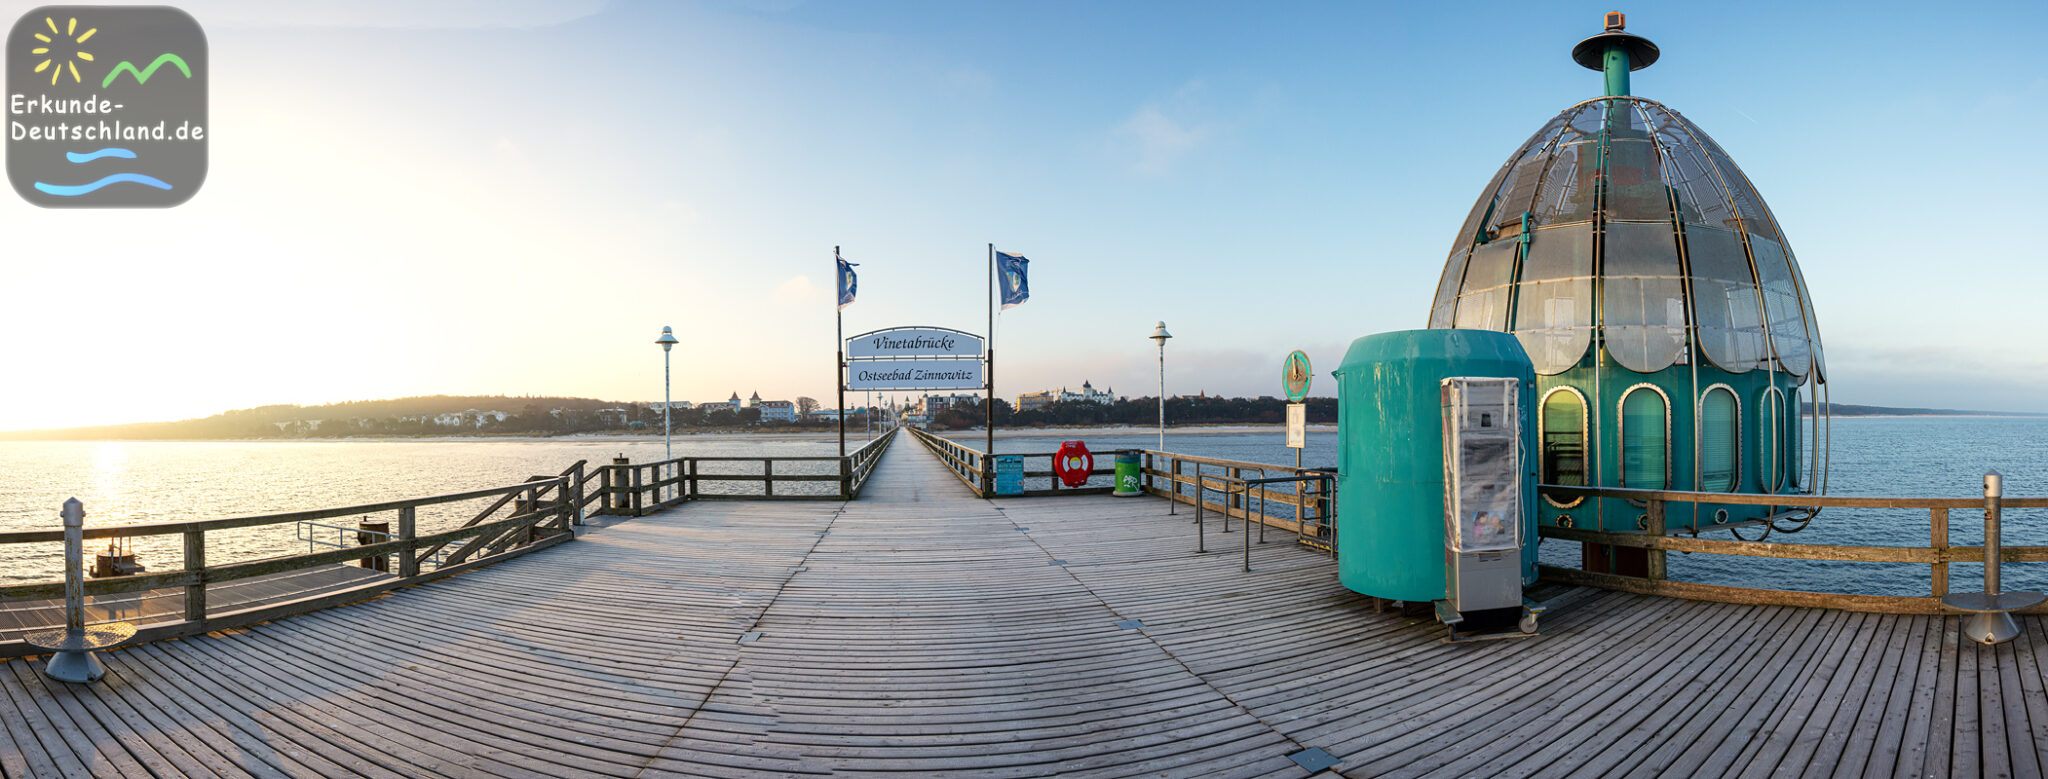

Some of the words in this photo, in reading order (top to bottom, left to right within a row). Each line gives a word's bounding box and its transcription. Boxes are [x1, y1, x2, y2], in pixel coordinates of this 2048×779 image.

[873, 335, 955, 351] Vinetabrücke
[858, 369, 913, 381] Ostseebad
[914, 369, 973, 381] Zinnowitz
